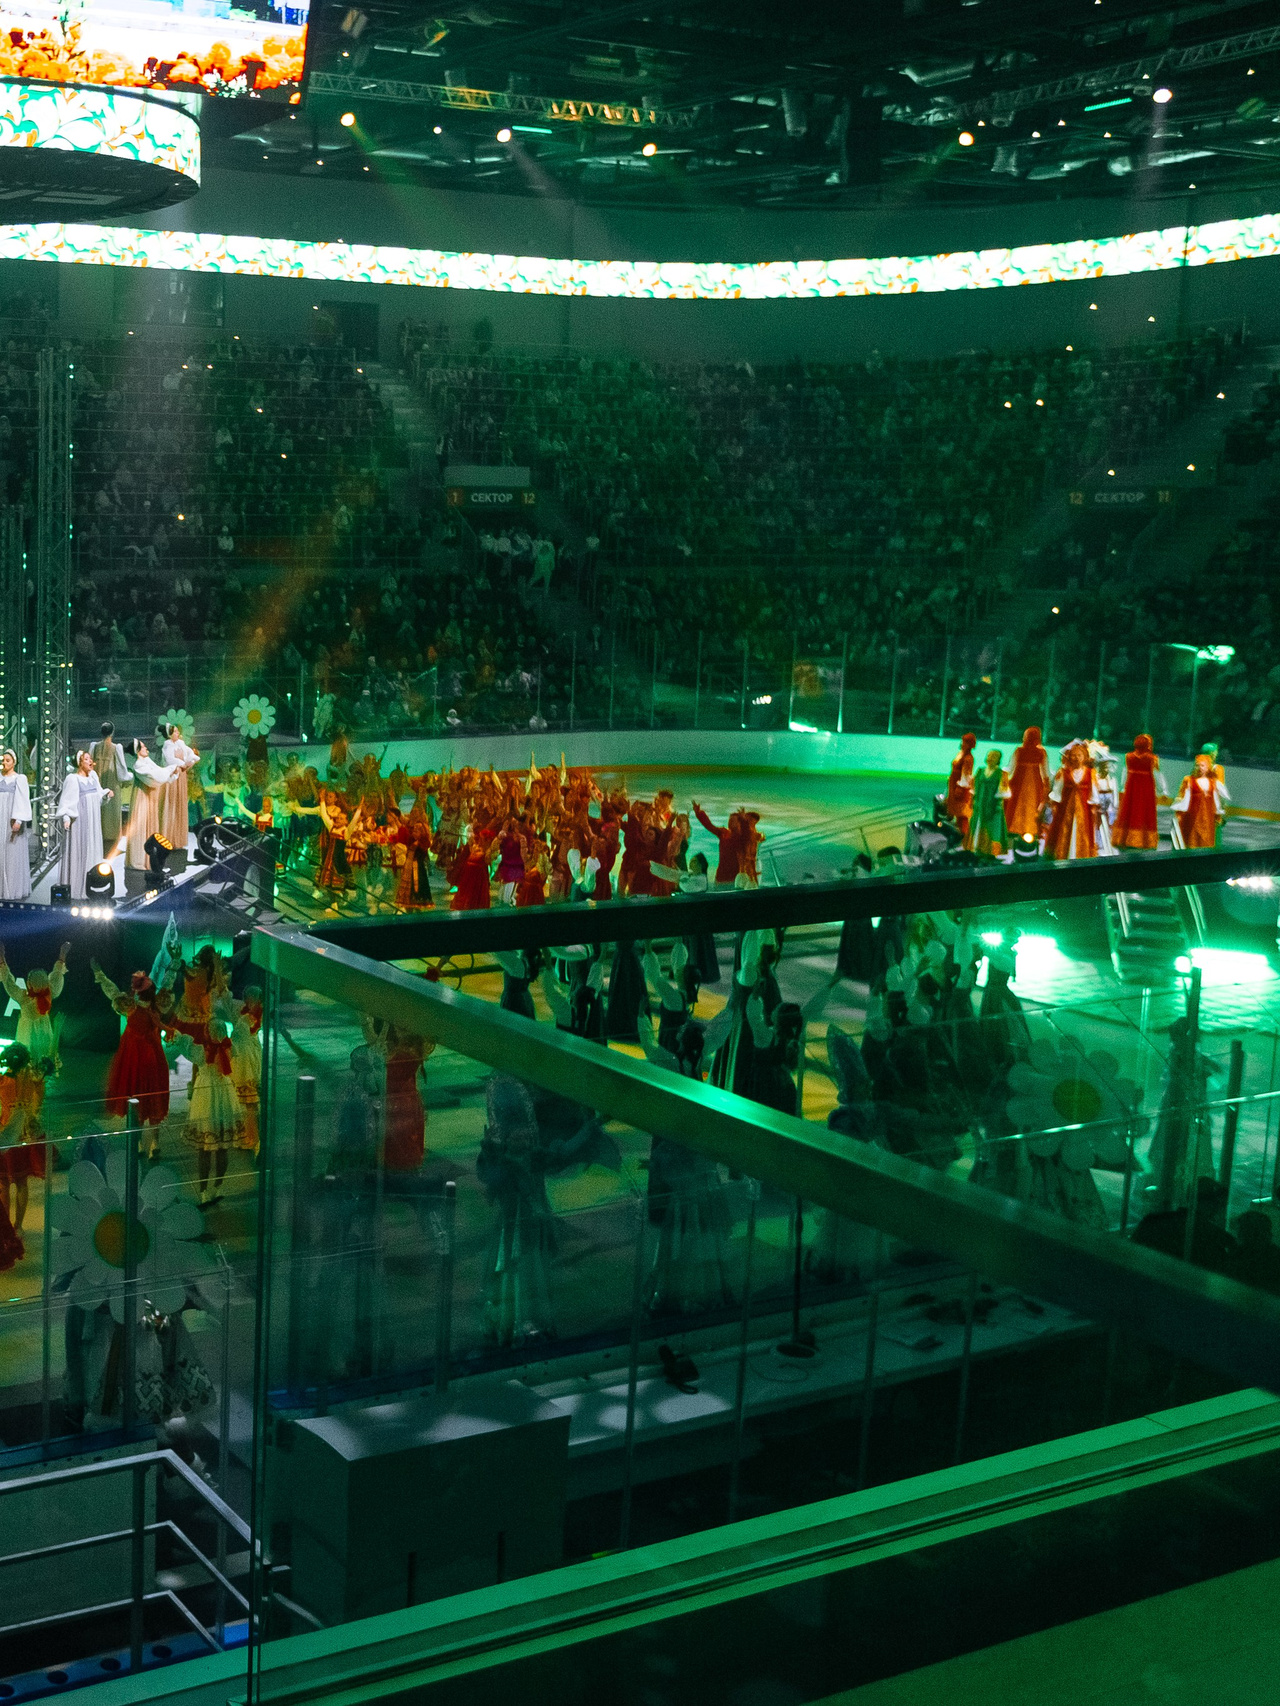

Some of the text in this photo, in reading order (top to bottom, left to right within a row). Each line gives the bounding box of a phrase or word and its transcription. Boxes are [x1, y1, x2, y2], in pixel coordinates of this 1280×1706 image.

[471, 492, 513, 503] СЕКТОР
[523, 492, 535, 504] 12
[1094, 492, 1145, 503] СЕКТОР
